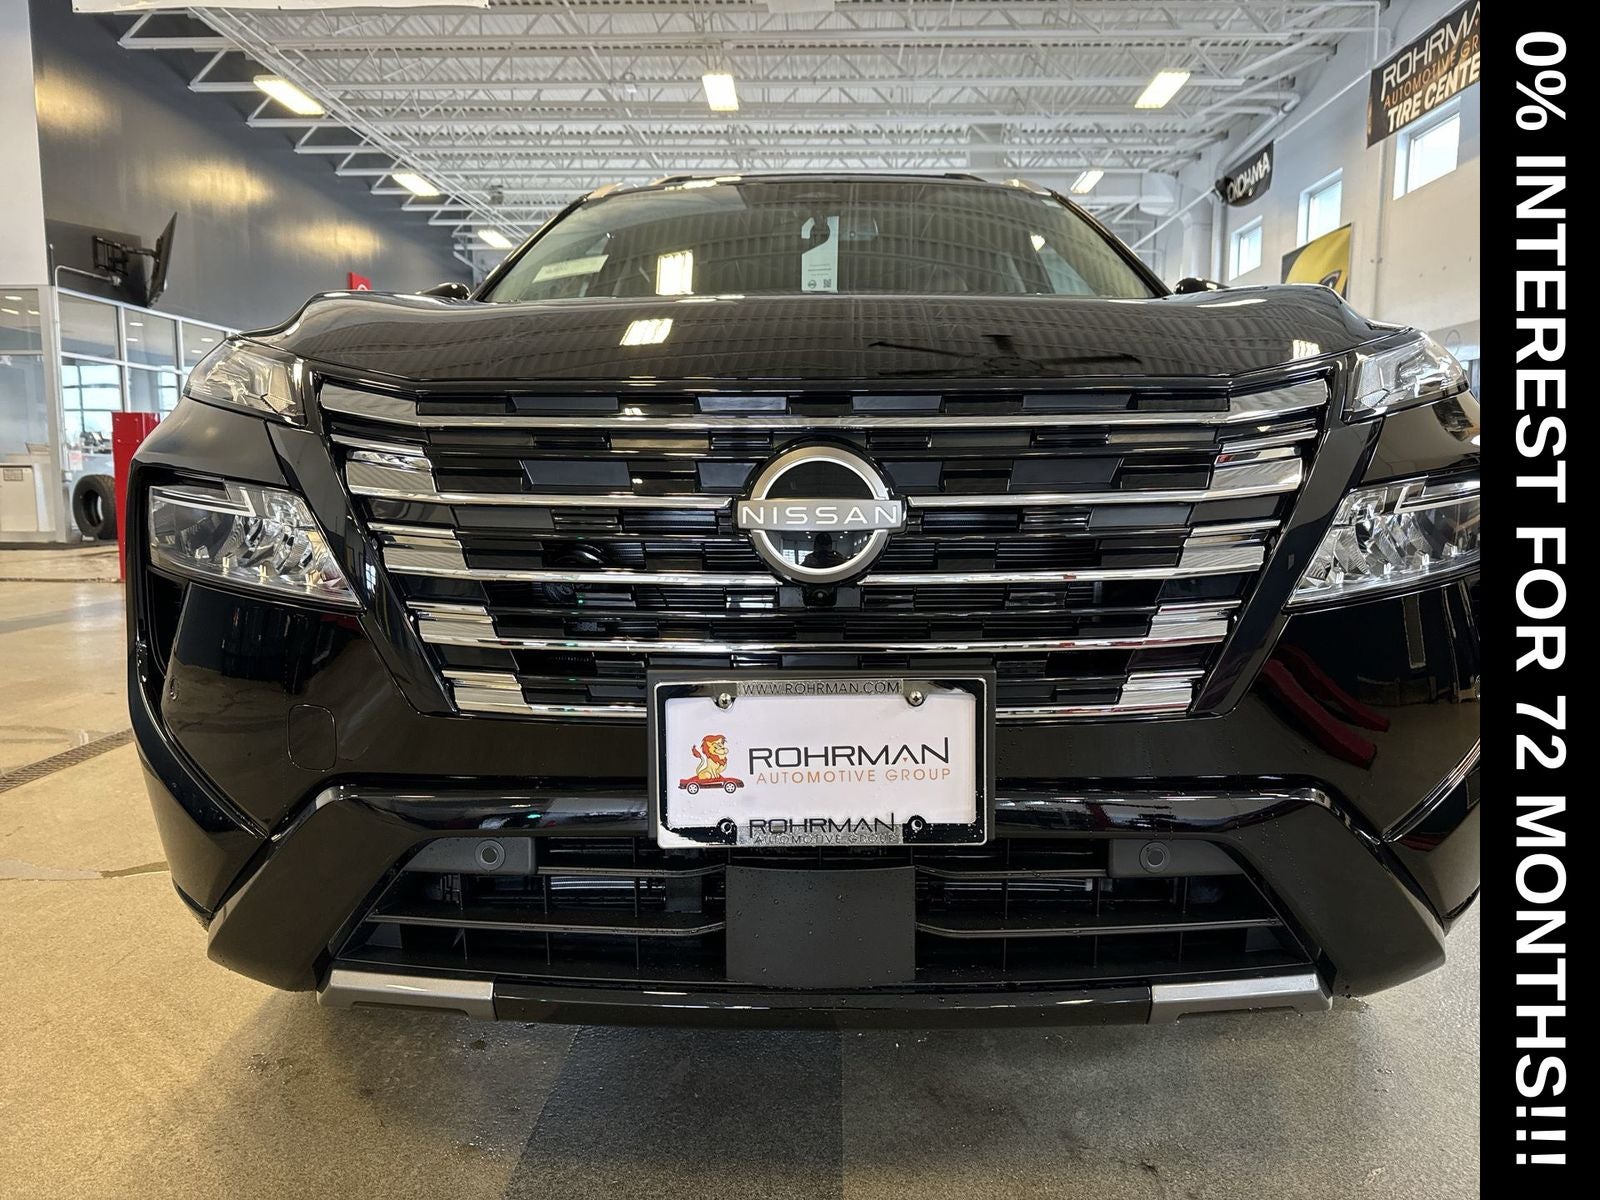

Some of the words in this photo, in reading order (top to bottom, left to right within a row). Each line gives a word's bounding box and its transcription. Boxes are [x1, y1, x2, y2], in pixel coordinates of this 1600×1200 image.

[1384, 49, 1457, 109] AUTOMOTIVE
[1387, 90, 1422, 133] TIRE
[742, 506, 897, 525] NISSAN
[743, 681, 900, 695] WWW.ROHRMAN.COM
[749, 737, 949, 775] ROHRMAN
[756, 769, 876, 785] AUTOMOTIVE
[885, 768, 951, 782] GROUP
[749, 812, 895, 838] ROHRMAN
[754, 834, 841, 845] AUTOMOTIVE
[848, 834, 896, 844] GROUP
